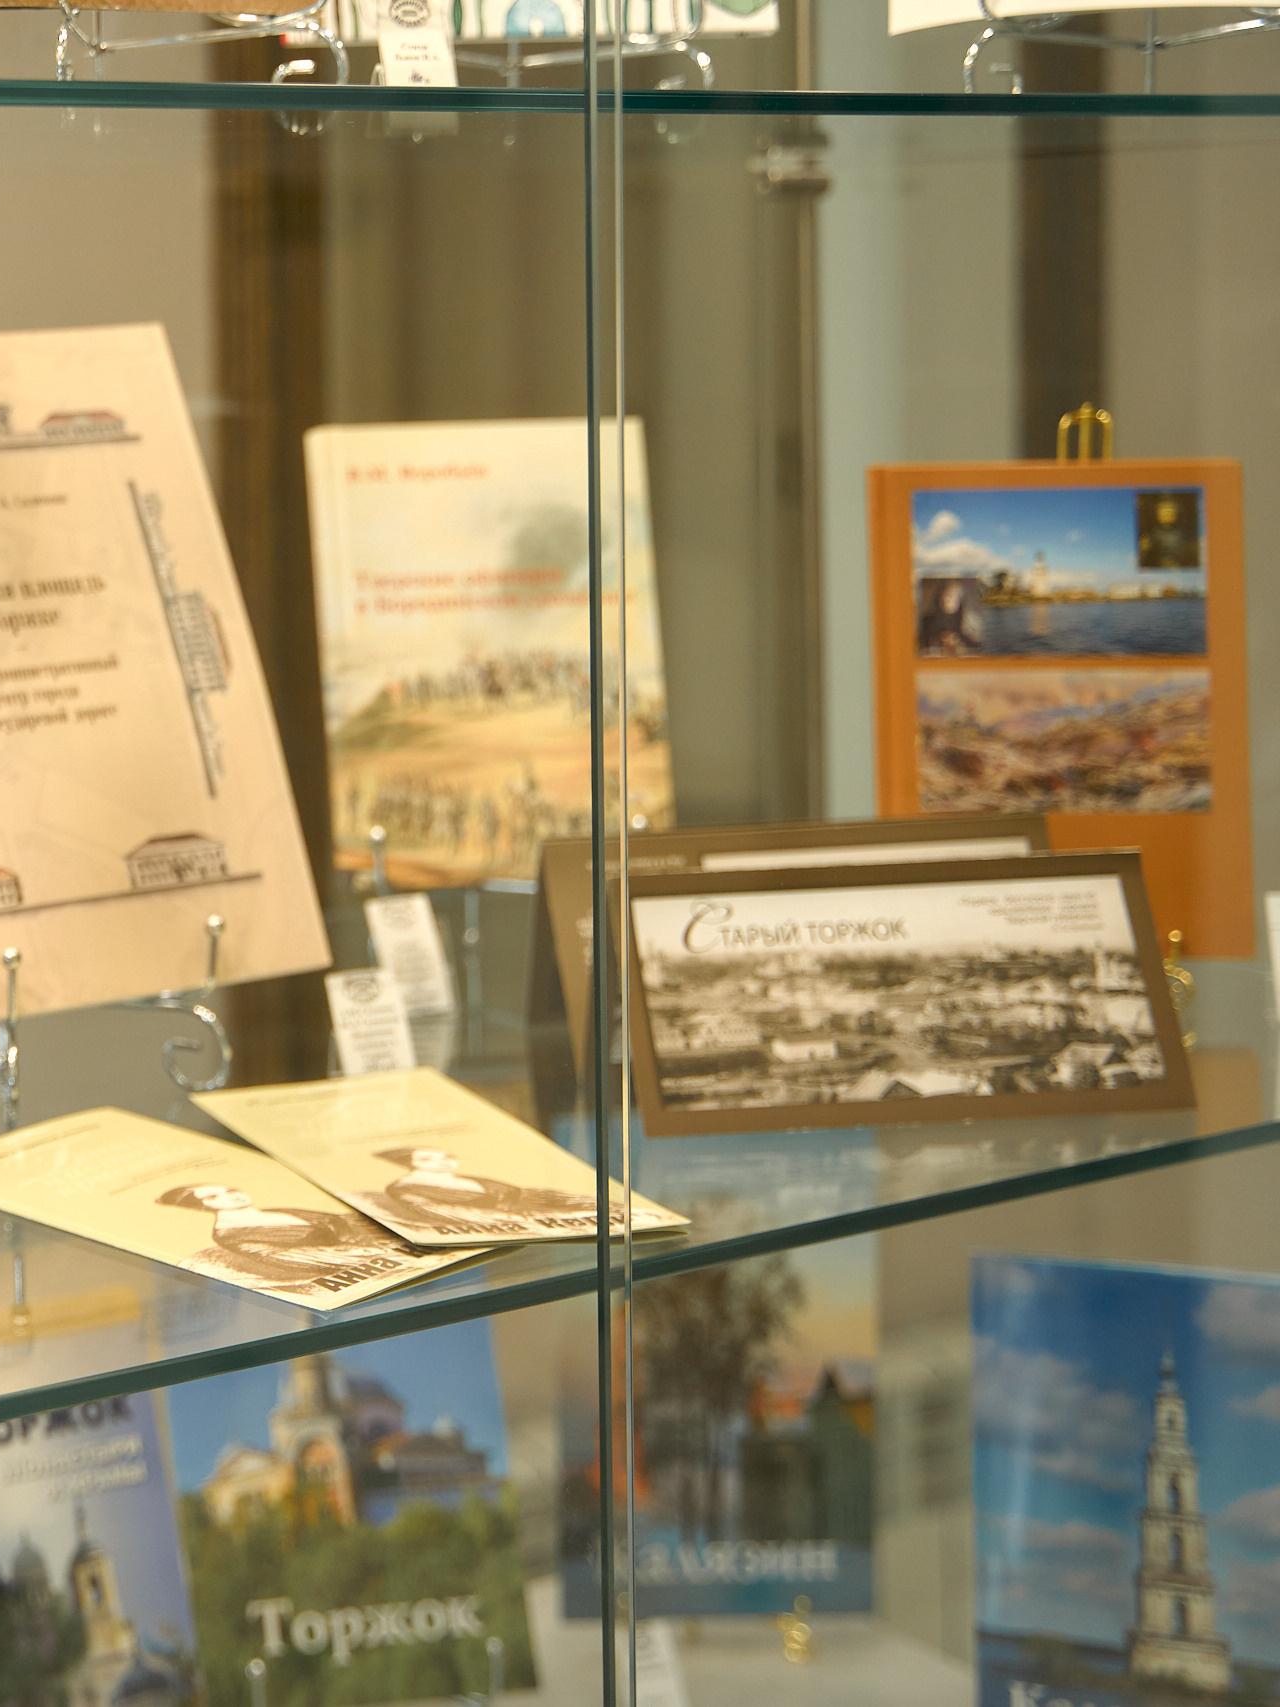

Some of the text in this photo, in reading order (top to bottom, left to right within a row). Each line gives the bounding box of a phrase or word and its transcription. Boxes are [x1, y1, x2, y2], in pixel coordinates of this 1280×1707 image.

[804, 916, 909, 945] ТОРЖОК
[433, 1221, 527, 1235] Анна
[312, 1258, 403, 1292] Анна
[245, 1594, 484, 1667] Торжок
